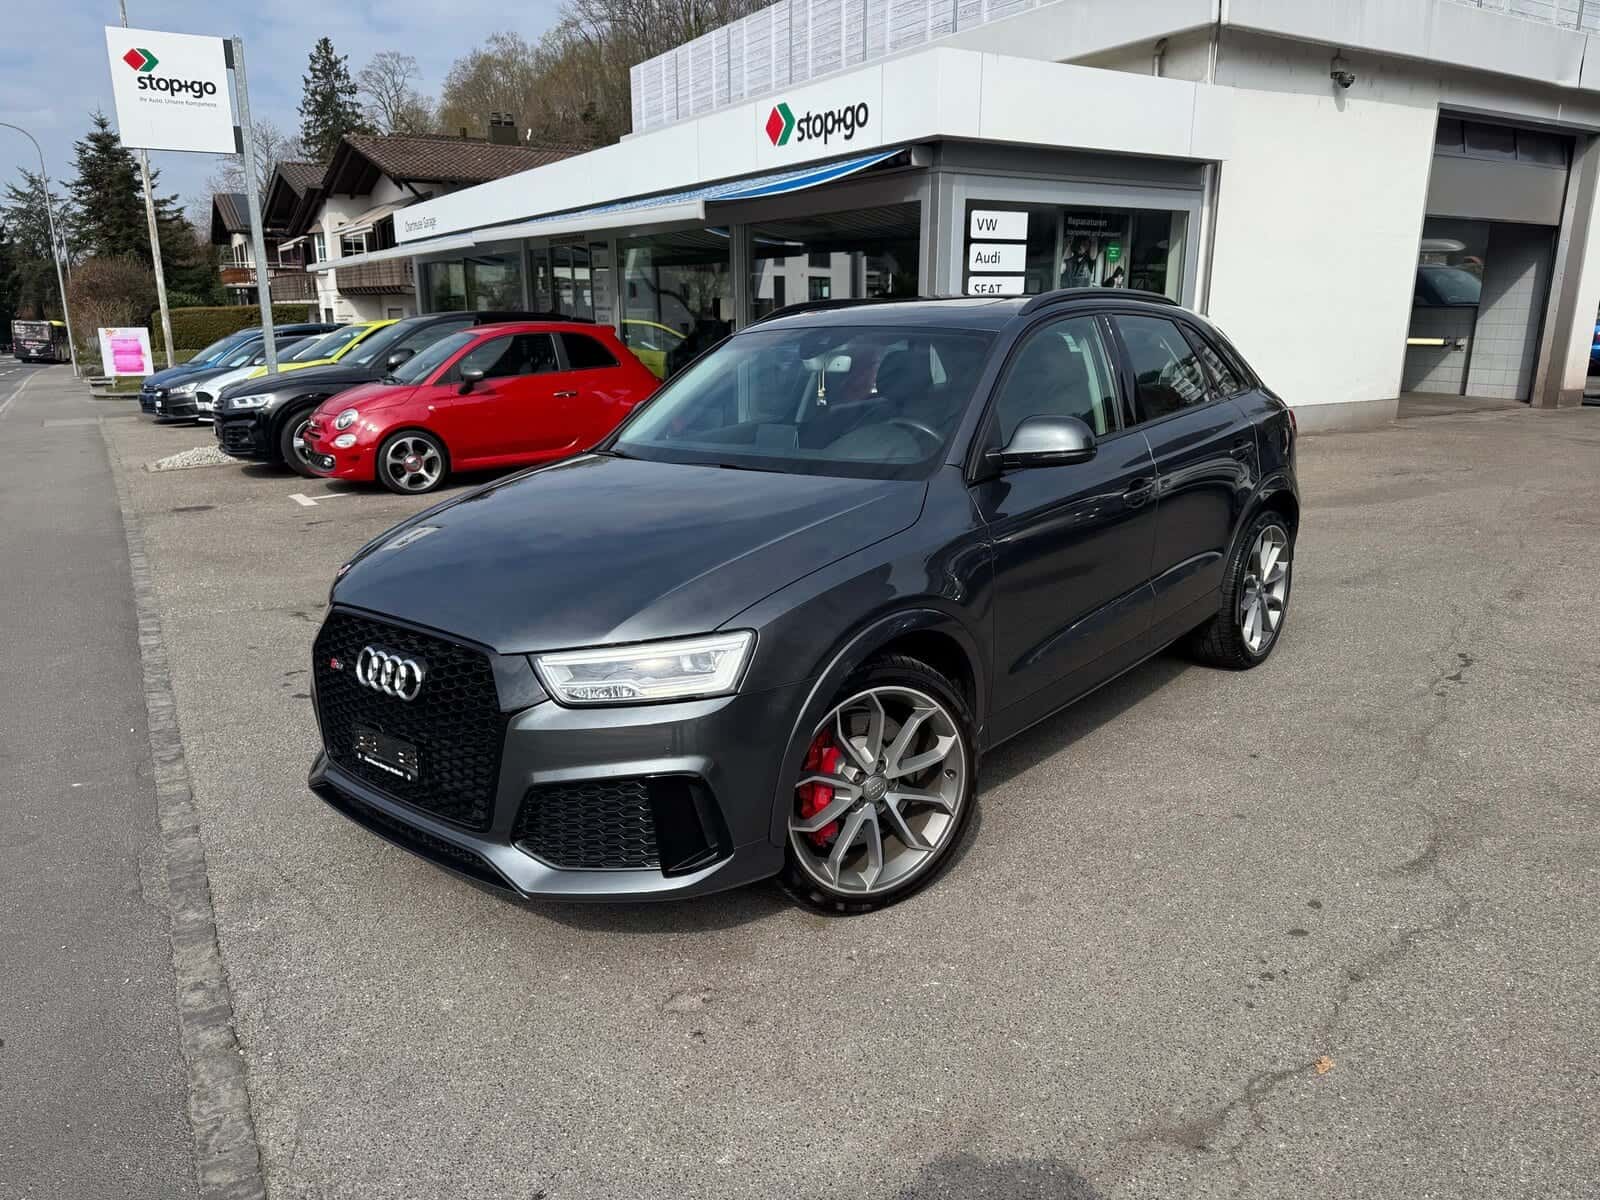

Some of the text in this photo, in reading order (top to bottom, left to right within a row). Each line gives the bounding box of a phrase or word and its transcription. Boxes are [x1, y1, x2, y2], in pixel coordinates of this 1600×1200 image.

[137, 74, 217, 99] stop+go
[797, 102, 869, 145] stop+go
[976, 218, 998, 231] VW
[975, 251, 1001, 264] Audi
[974, 283, 1003, 294] SEAT
